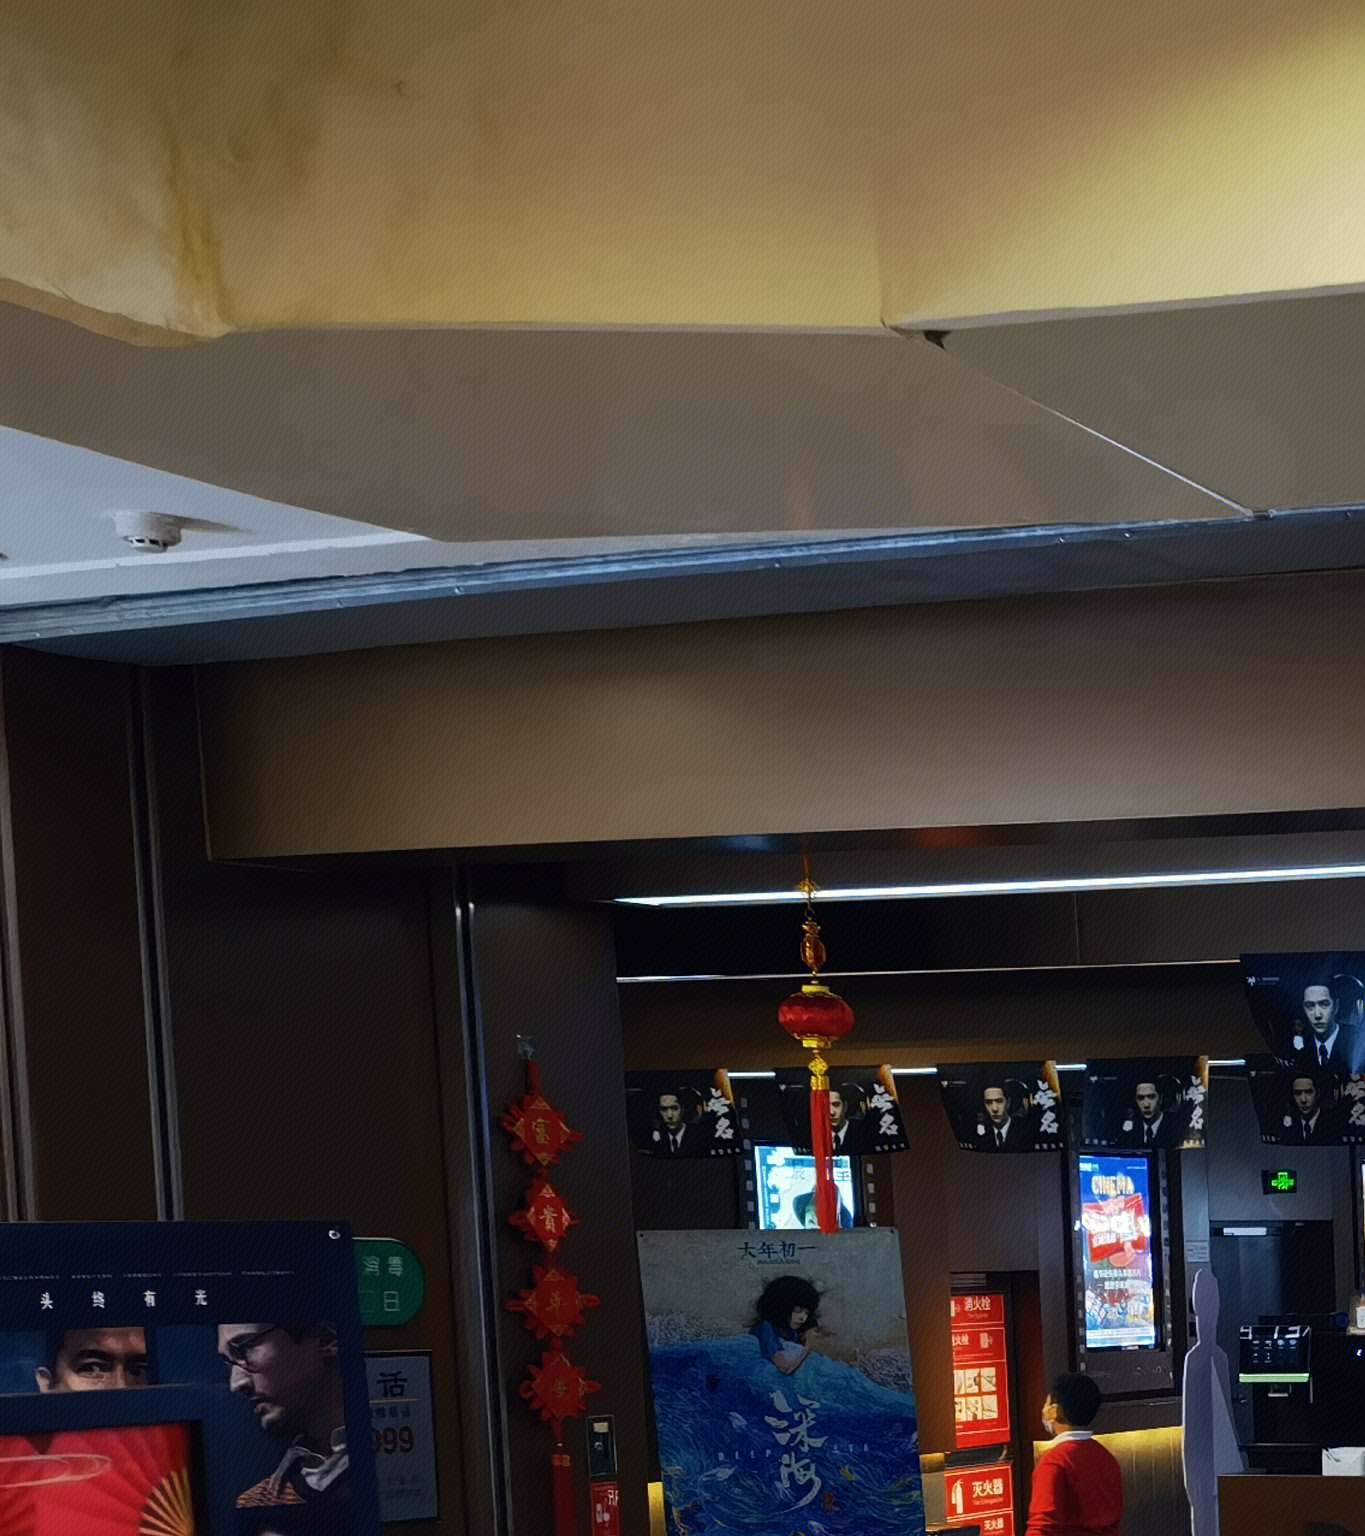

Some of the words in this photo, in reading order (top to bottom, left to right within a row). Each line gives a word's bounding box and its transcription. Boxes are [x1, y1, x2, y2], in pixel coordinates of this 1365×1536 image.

[738, 1240, 818, 1259] 大年初一
[972, 1477, 1004, 1498] 灭火器
